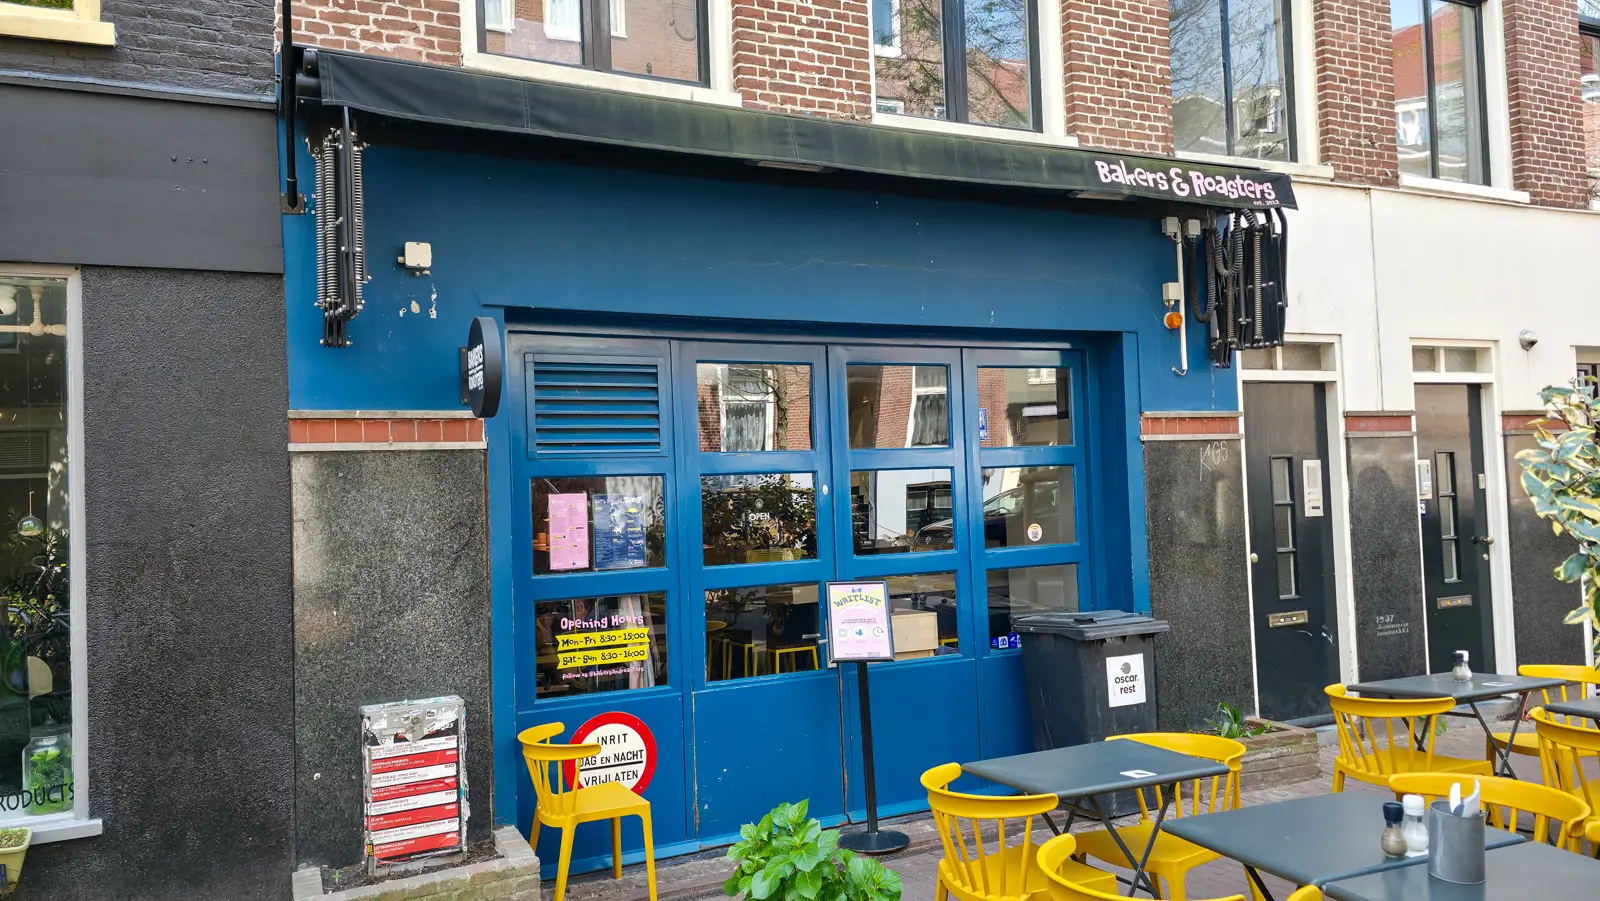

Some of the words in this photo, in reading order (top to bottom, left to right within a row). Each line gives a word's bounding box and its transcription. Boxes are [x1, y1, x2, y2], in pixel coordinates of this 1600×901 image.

[1095, 159, 1169, 191] Bakers
[1169, 167, 1190, 197] &
[1188, 170, 1276, 200] Roasters
[749, 512, 770, 521] OPEN
[833, 593, 882, 608] WAITLIST
[560, 616, 608, 631] Opening
[611, 614, 644, 627] Hours
[1119, 684, 1136, 694] rest
[596, 733, 628, 746] INRIT
[600, 756, 611, 765] EN
[613, 749, 644, 763] NACHT
